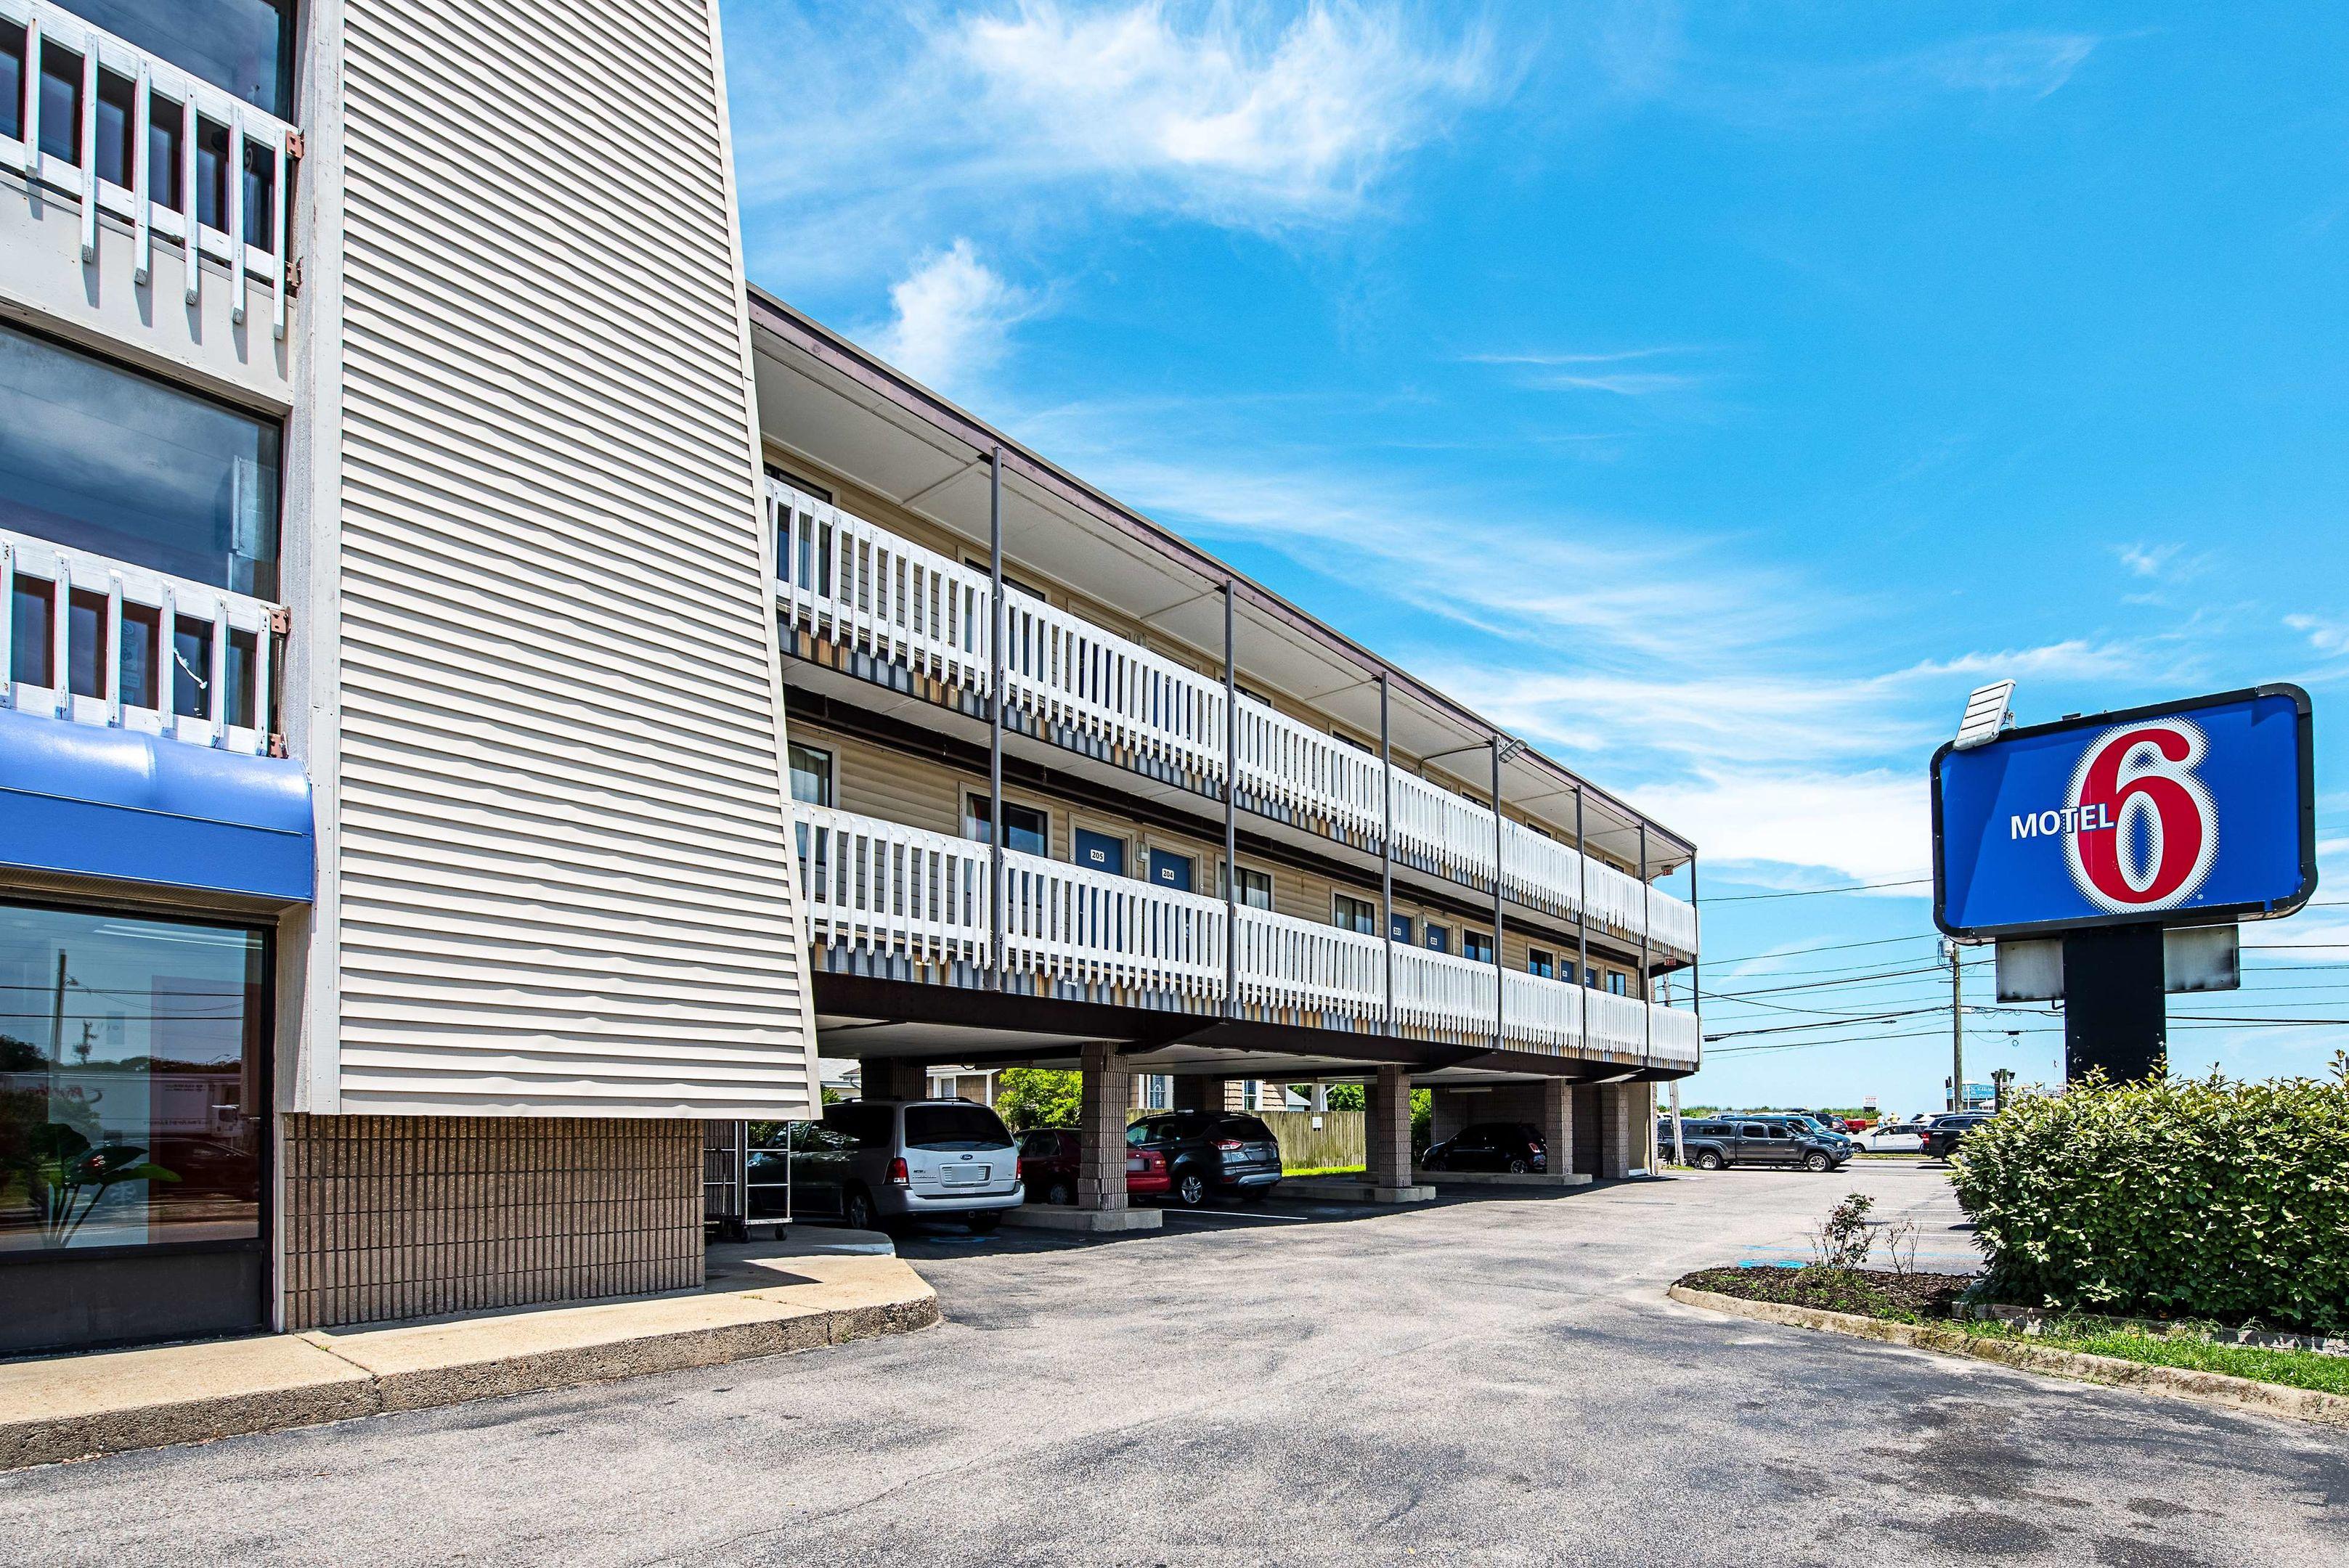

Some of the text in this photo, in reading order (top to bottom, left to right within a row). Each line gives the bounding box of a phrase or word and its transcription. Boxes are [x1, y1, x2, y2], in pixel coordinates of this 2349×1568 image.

[2011, 728, 2203, 905] MOTEL 6
[1091, 851, 1104, 860] 205
[1163, 870, 1173, 878] 204
